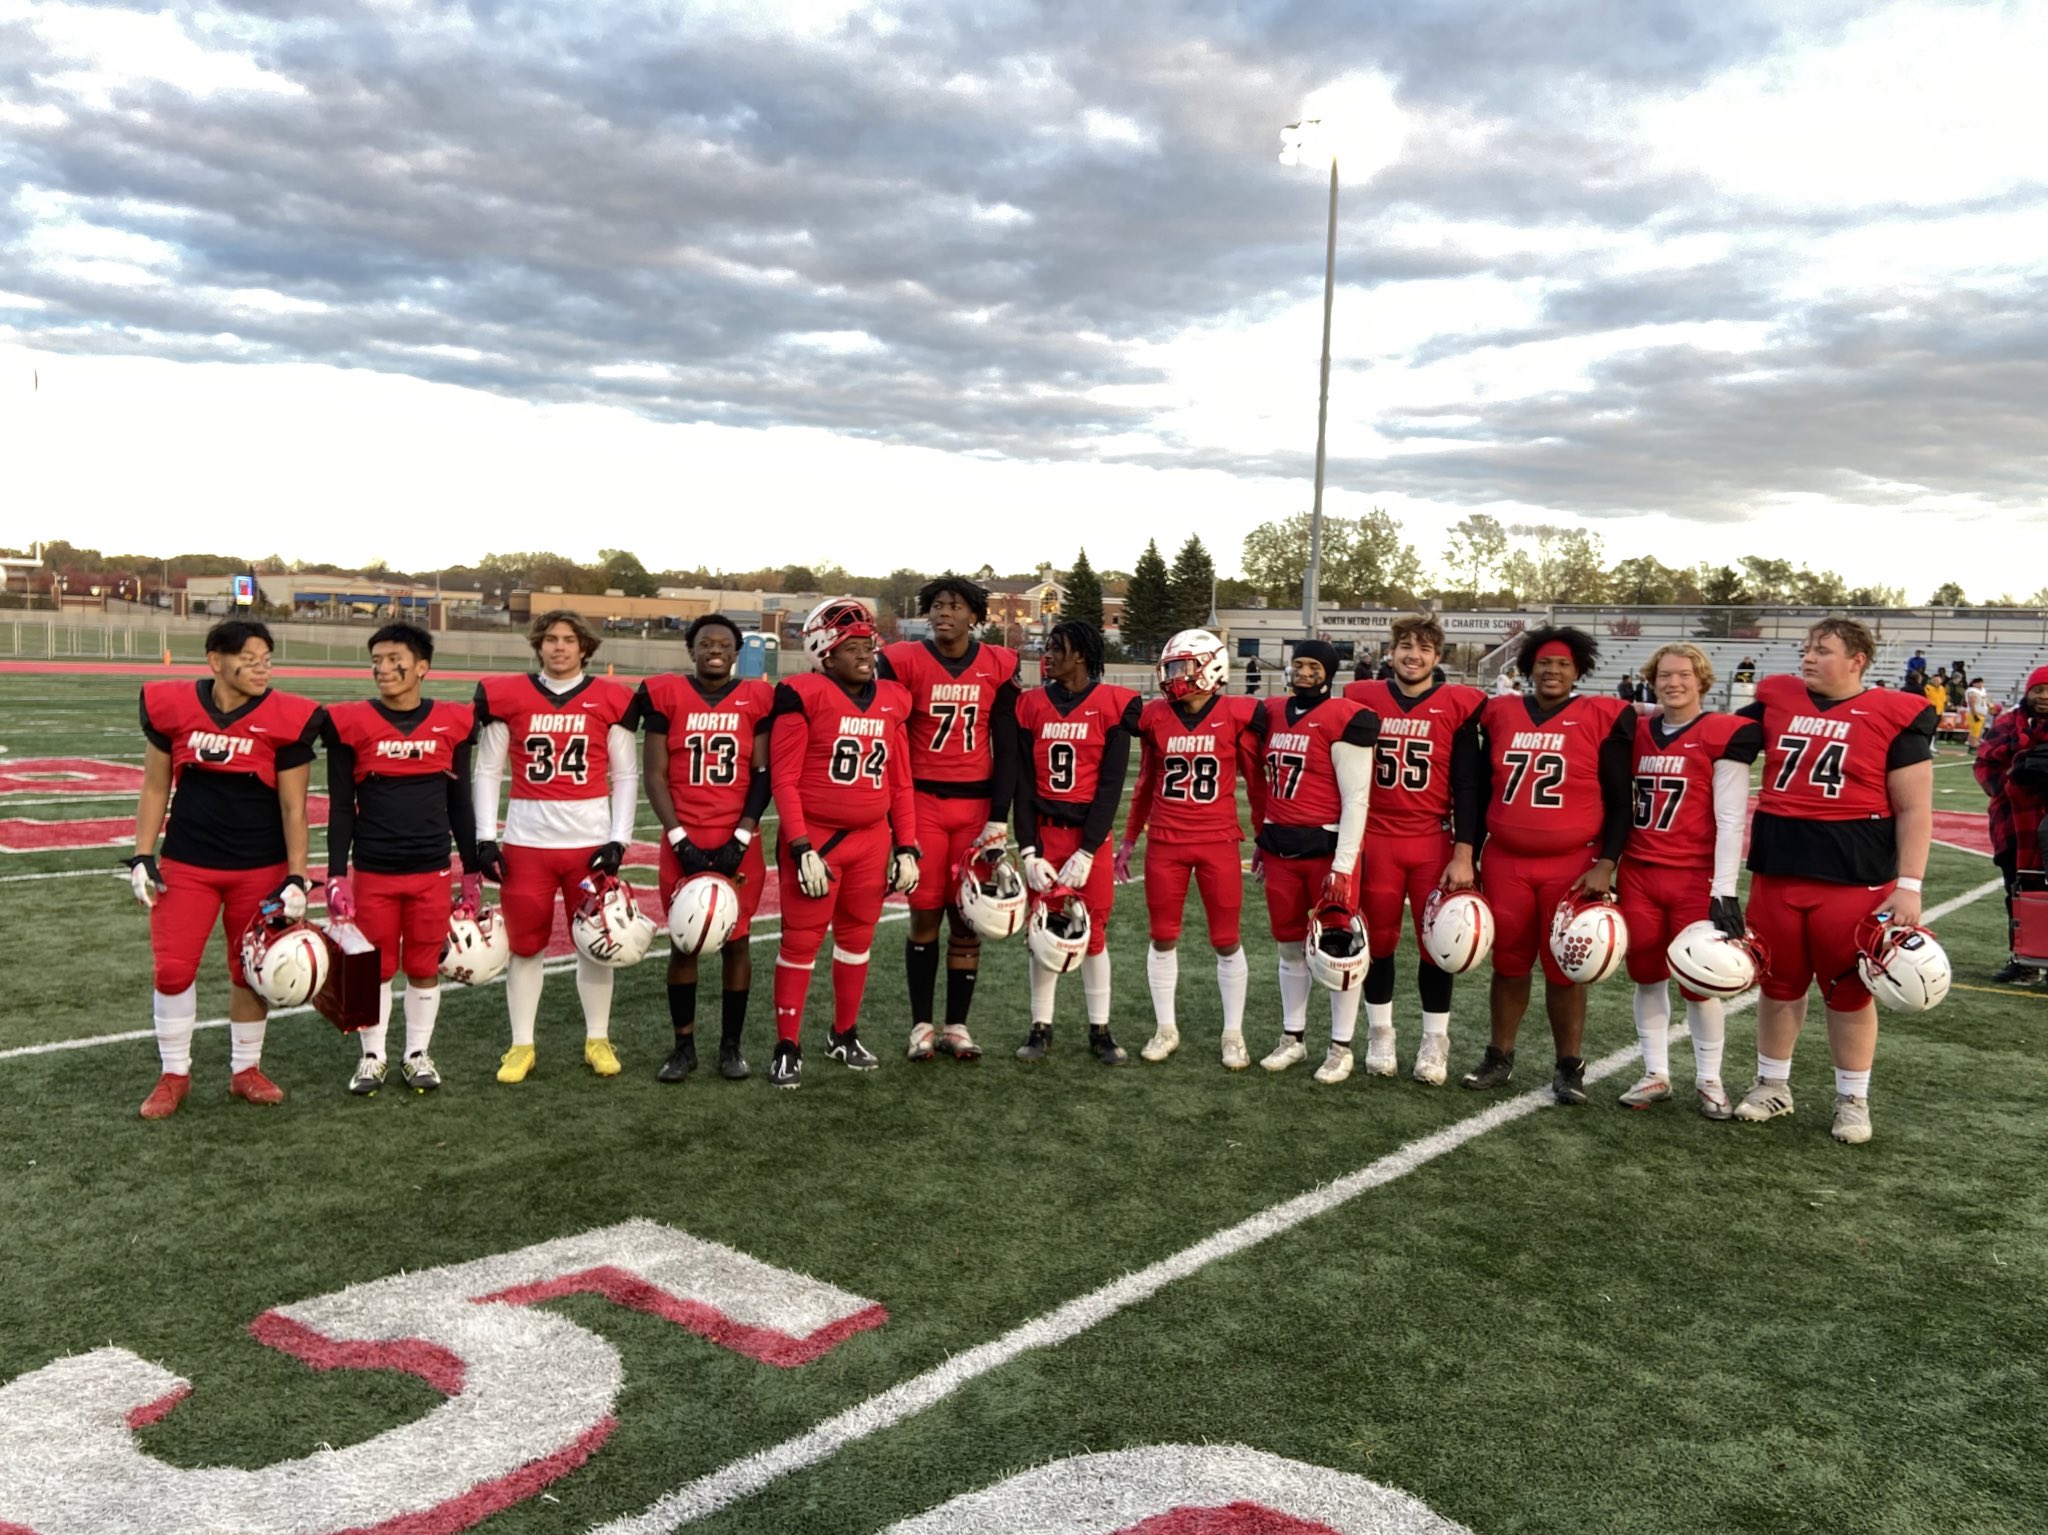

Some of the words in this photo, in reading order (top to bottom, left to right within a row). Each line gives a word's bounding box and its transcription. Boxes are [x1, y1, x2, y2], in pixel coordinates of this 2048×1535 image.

[1322, 615, 1345, 625] NORTH
[1347, 616, 1370, 626] METRO
[1372, 616, 1388, 626] FLEX
[1452, 618, 1490, 628] CHARTER
[931, 684, 981, 702] NORTH
[529, 713, 586, 733] NORTH
[685, 713, 739, 731] NORTH
[839, 716, 884, 737] NORTH
[929, 702, 979, 752] 71
[1041, 722, 1088, 740] NORTH
[1380, 717, 1432, 738] NORTH
[1788, 715, 1851, 740] NORTH
[187, 730, 254, 755] NORTH
[376, 739, 437, 757] NORTH
[1166, 735, 1216, 753] NORTH
[1269, 732, 1311, 753] NORTH
[1510, 732, 1565, 751] NORTH
[524, 733, 589, 785] 34
[685, 733, 739, 786] 13
[828, 736, 888, 789] 64
[1048, 741, 1076, 792] 9
[1375, 736, 1434, 792] 55
[1638, 755, 1686, 774] NORTH
[1775, 735, 1849, 799] 74
[1162, 754, 1219, 803] 28
[1266, 751, 1306, 800] 17
[1502, 750, 1565, 808] 72
[1633, 775, 1688, 832] 57
